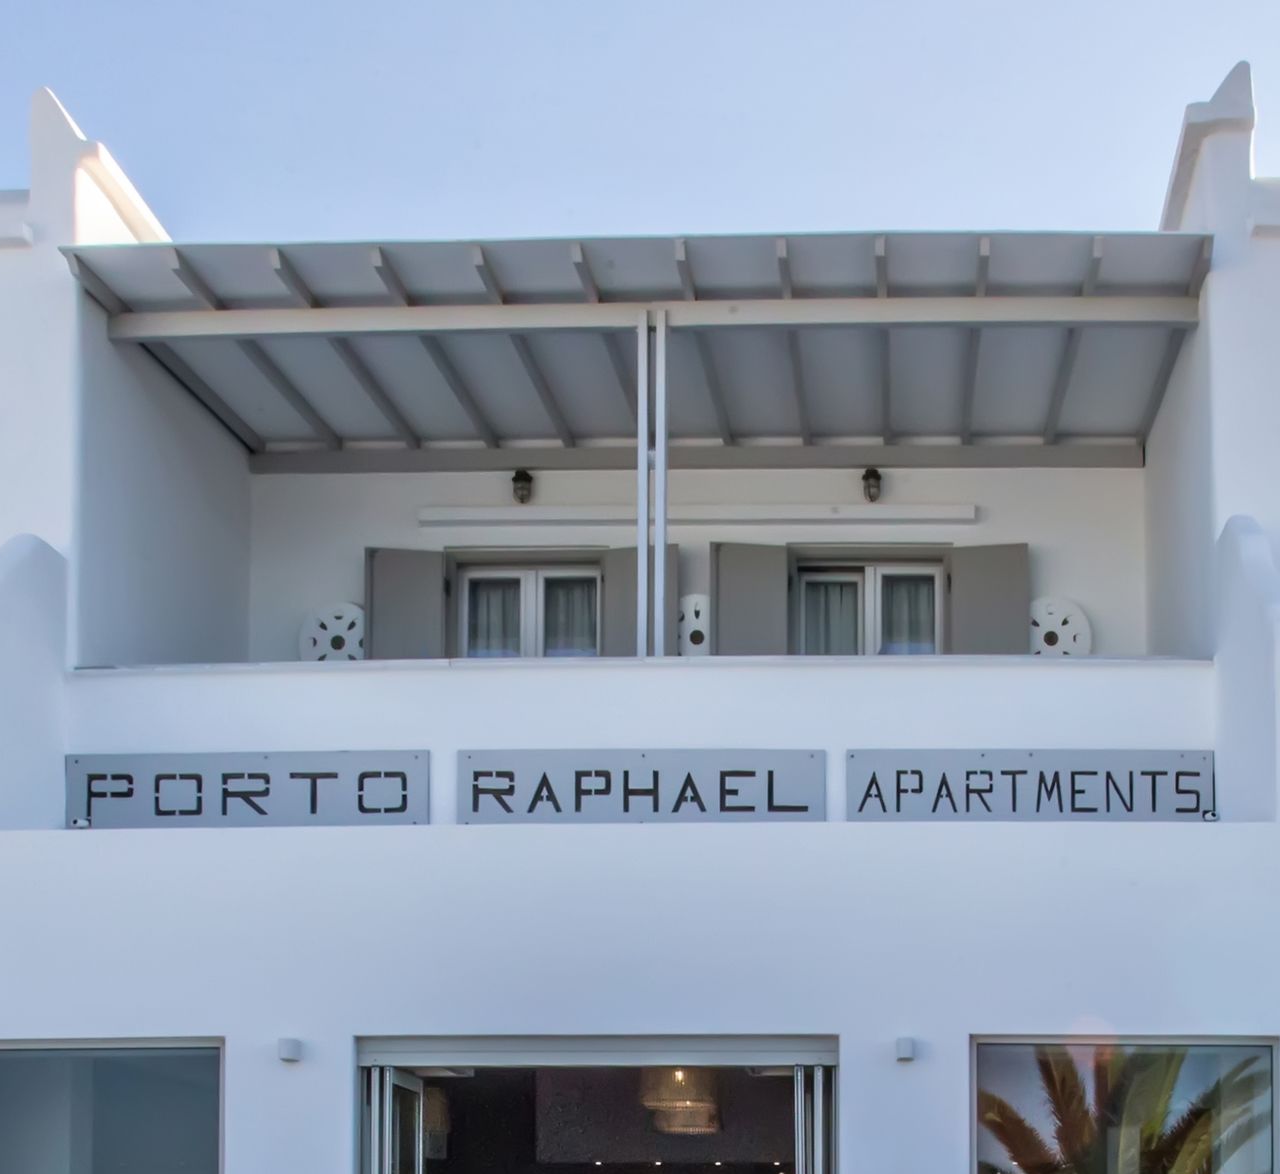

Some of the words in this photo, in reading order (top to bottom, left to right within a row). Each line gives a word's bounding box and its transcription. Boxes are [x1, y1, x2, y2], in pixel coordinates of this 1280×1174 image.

[86, 770, 408, 818] PORTO
[472, 770, 809, 813] RAPHAEL
[858, 769, 1201, 813] APARTMENTS
